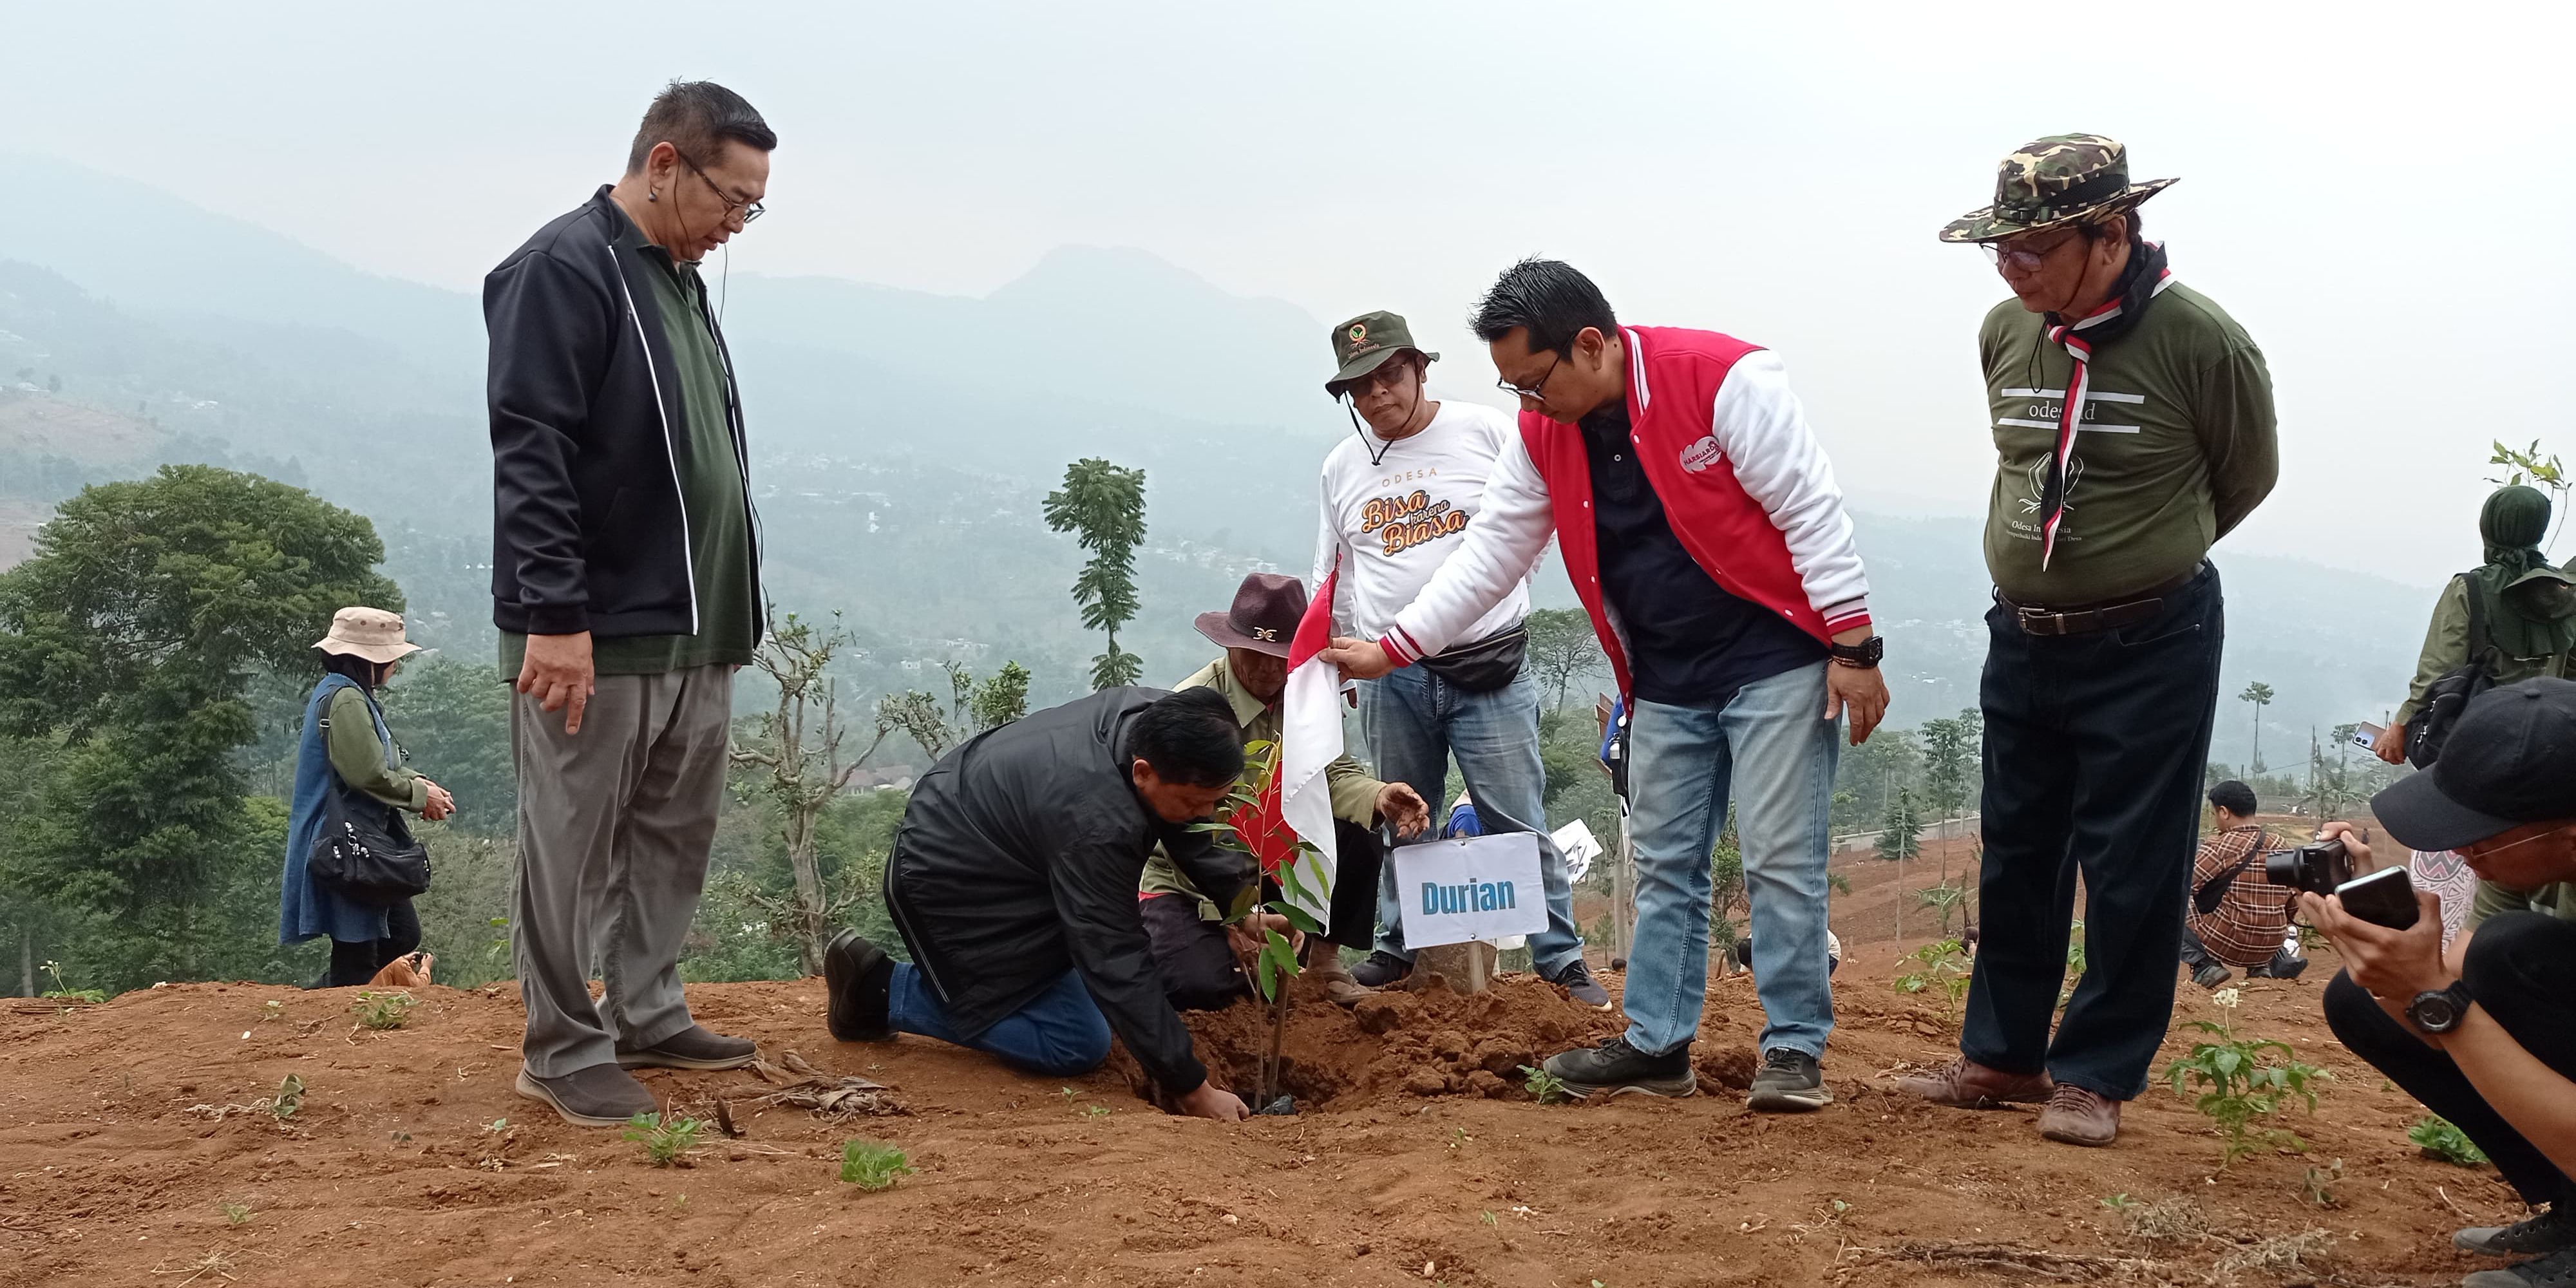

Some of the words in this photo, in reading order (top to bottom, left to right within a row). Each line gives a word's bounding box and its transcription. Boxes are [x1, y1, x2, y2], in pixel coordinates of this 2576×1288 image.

[1382, 468, 1437, 488] ODESA
[1361, 489, 1430, 533] Bisa
[1410, 500, 1450, 526] karena
[1381, 510, 1470, 557] Biasa
[1421, 877, 1516, 916] Durian
